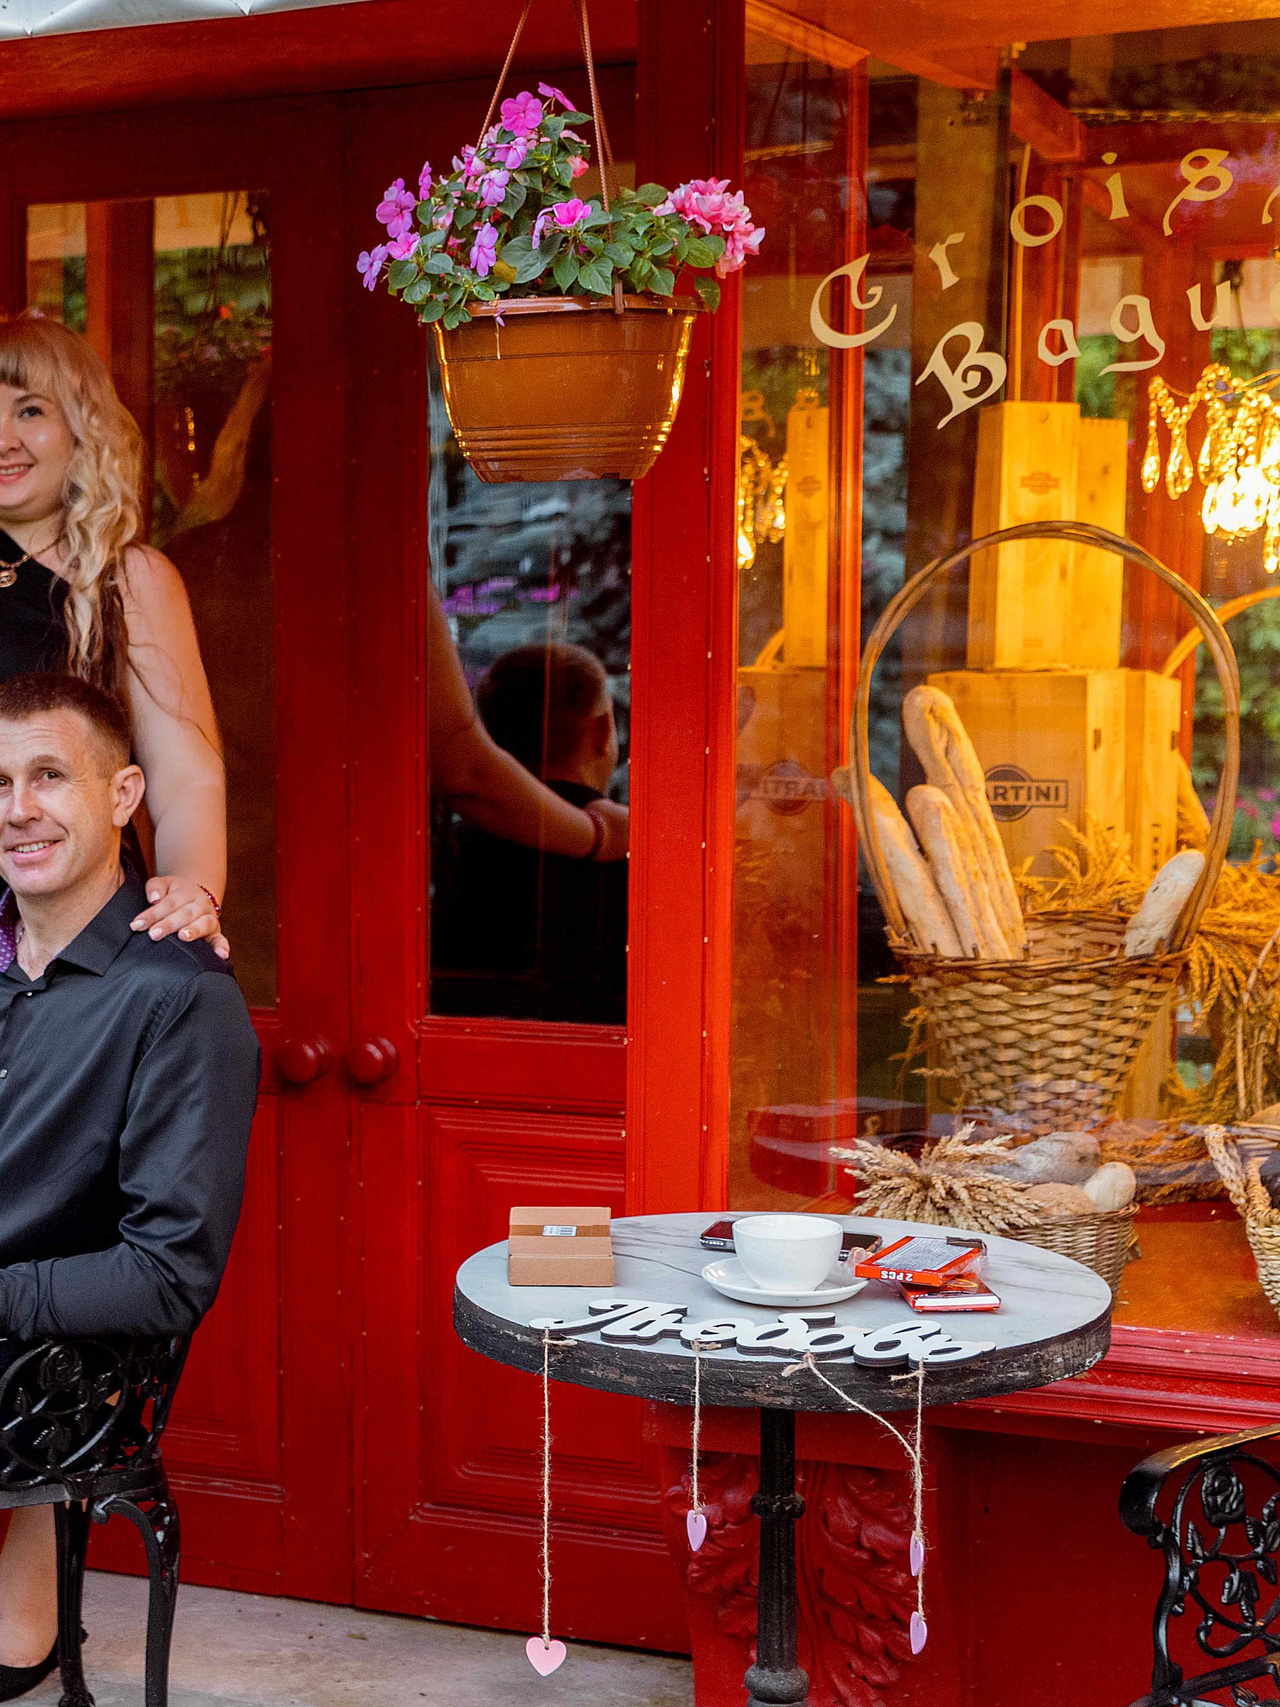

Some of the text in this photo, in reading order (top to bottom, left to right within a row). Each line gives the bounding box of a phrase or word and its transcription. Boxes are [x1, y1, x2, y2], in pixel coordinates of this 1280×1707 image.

[810, 147, 1280, 349] Crois
[915, 279, 1280, 430] Bagu
[987, 786, 1060, 801] RTINI
[880, 1270, 904, 1281] PCS
[529, 1298, 997, 1370] Любовь
